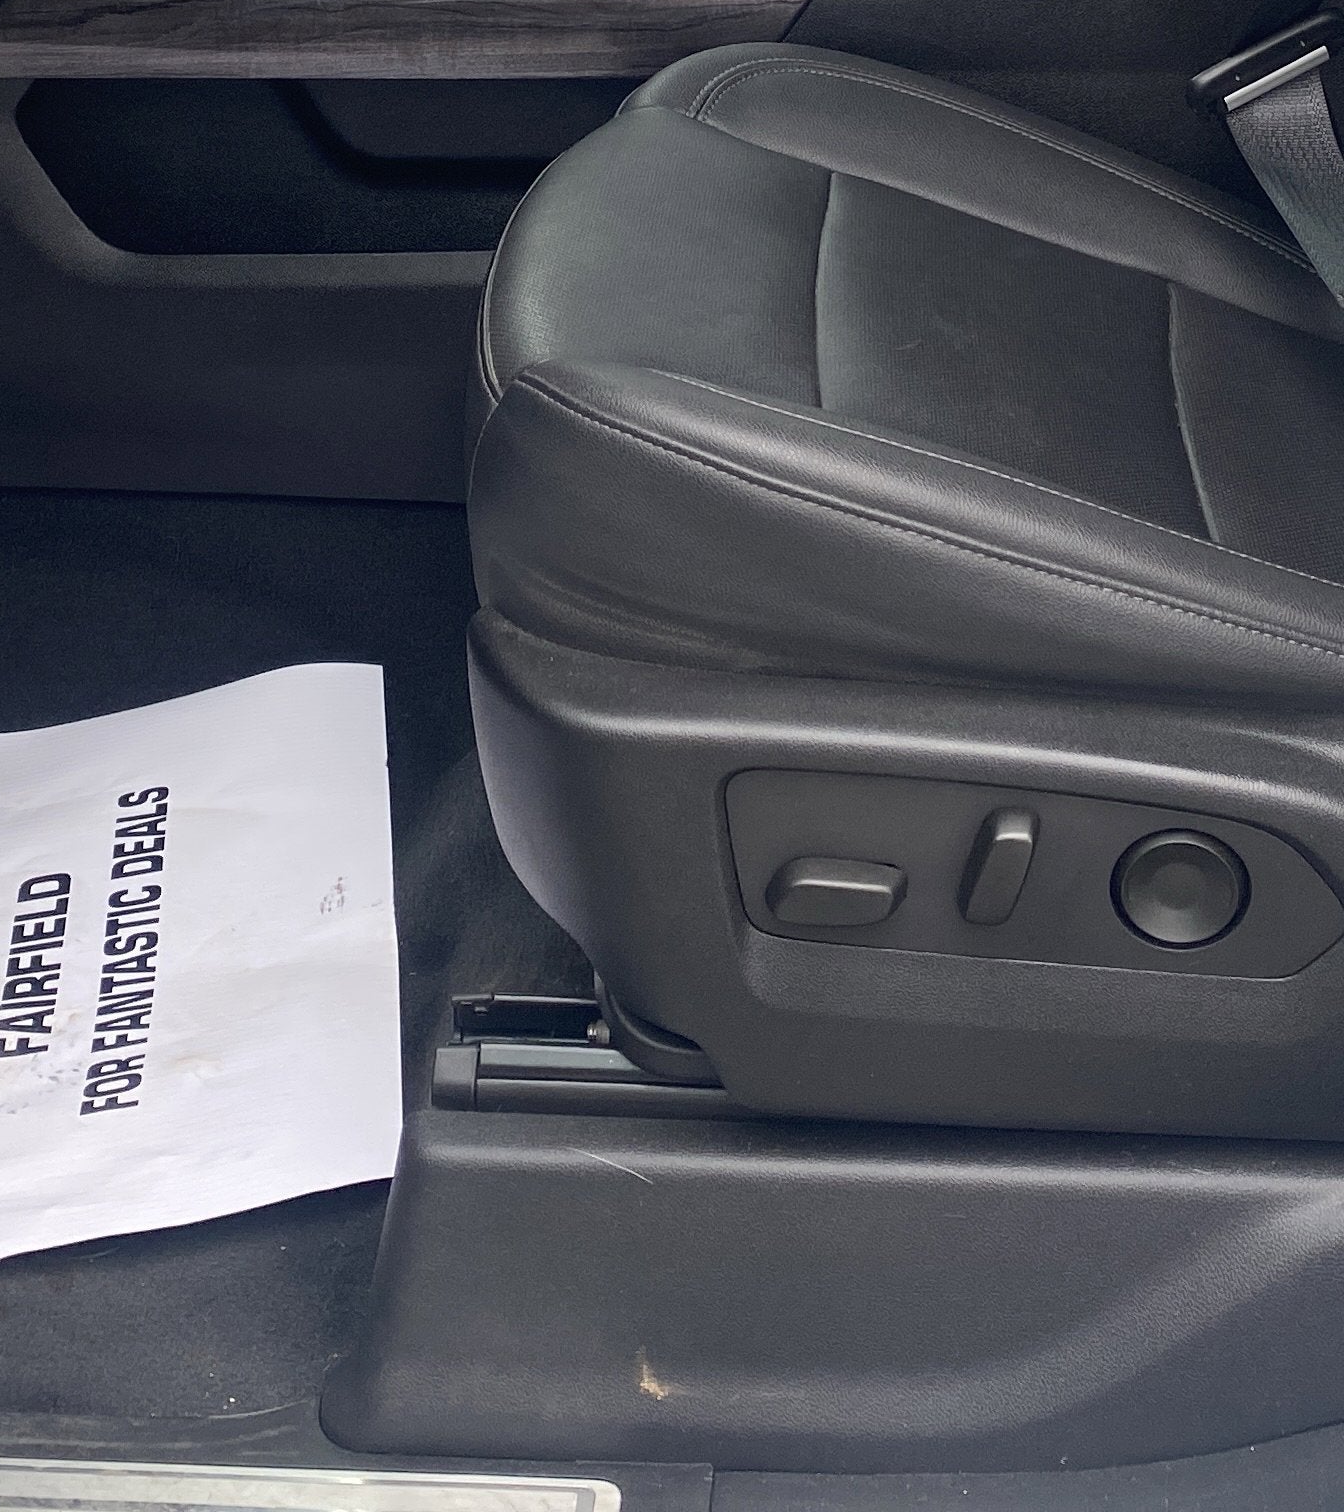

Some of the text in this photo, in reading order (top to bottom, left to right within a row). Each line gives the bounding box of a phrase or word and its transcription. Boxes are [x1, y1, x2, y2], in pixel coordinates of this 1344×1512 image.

[79, 786, 169, 1116] FOR FANTASTIC DEALS
